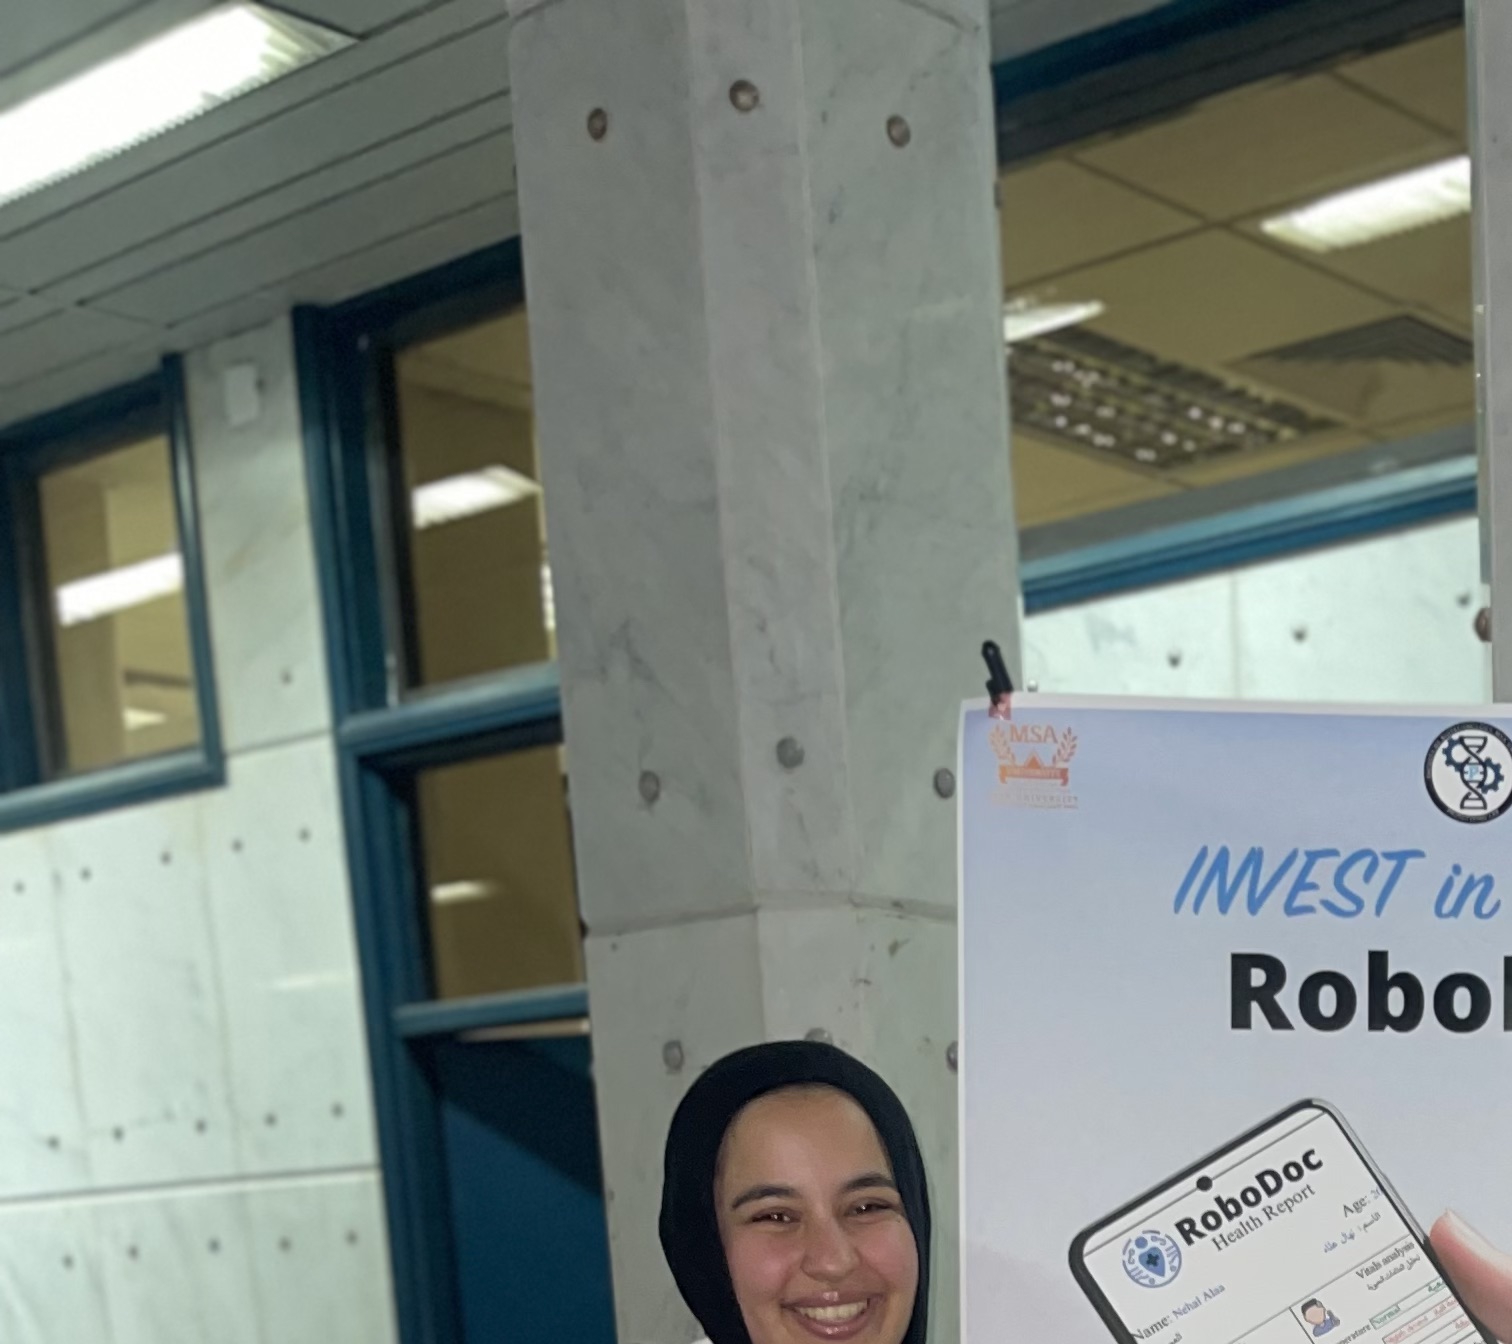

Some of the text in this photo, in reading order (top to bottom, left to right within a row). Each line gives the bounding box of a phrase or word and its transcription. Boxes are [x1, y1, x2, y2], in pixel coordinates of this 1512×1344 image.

[1009, 723, 1058, 744] MSA
[1173, 845, 1427, 921] INVEST
[1433, 863, 1502, 922] in
[1174, 1148, 1324, 1247] RoboDoc
[1342, 1194, 1370, 1218] Age:
[1211, 1183, 1317, 1252] Health Report
[1355, 1241, 1415, 1279] Vitals analysis
[1132, 1313, 1174, 1342] Name:
